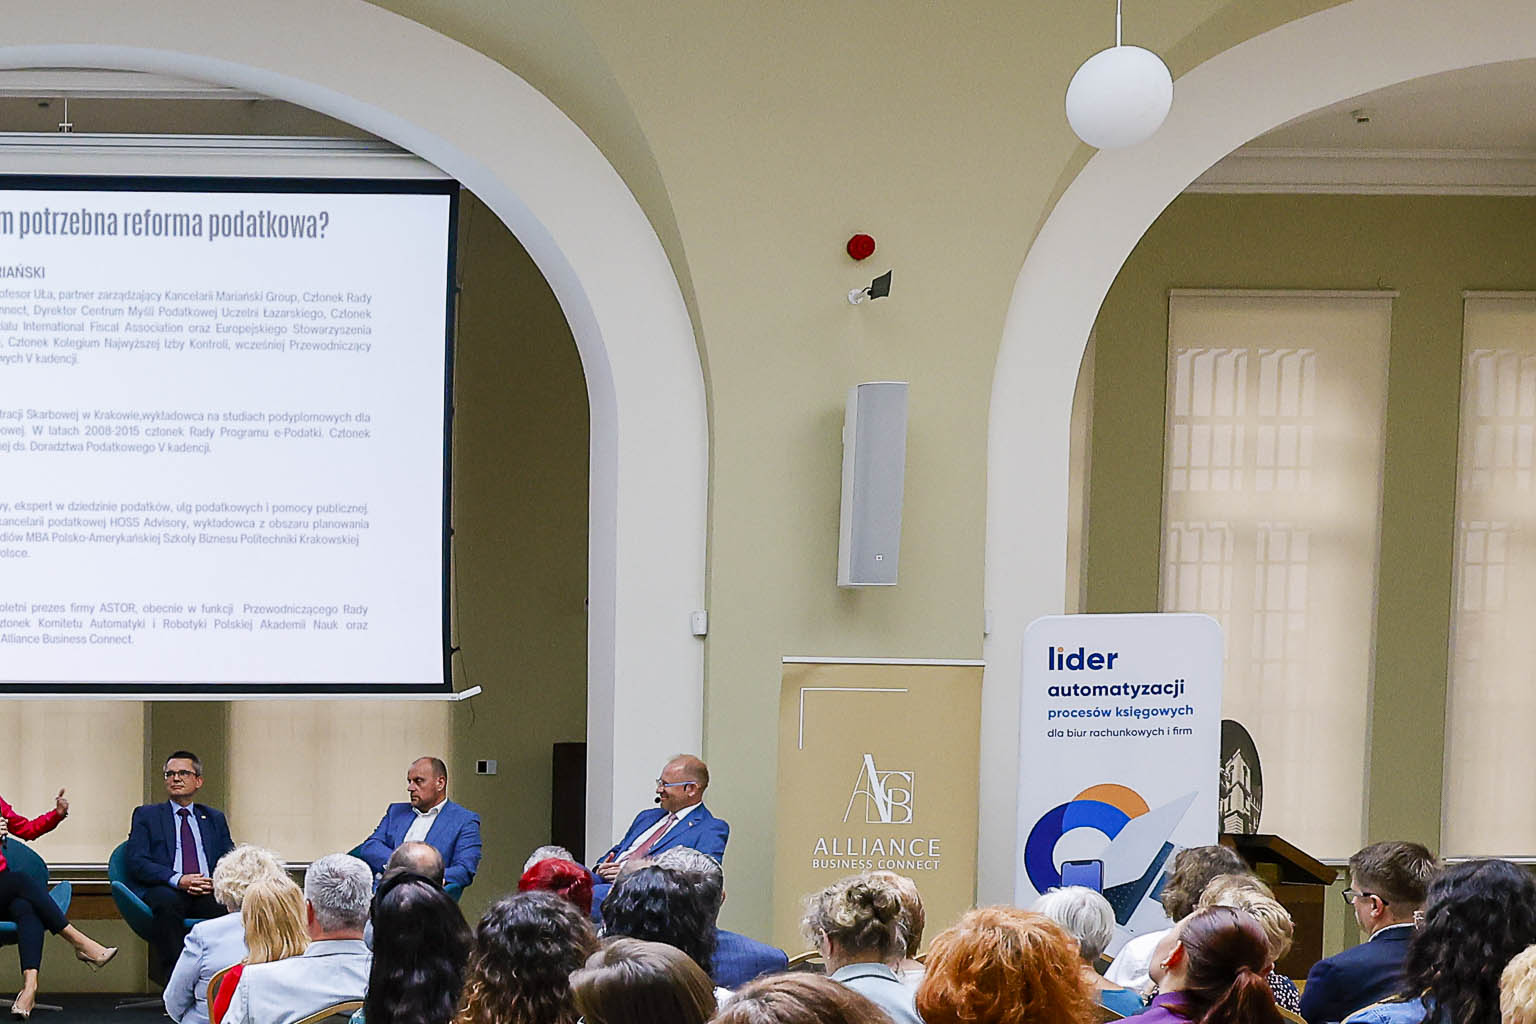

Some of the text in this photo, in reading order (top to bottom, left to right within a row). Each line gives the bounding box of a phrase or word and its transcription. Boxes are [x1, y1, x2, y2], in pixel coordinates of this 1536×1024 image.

[19, 207, 117, 240] potrzebna
[123, 208, 202, 237] reforma
[209, 209, 329, 243] podatkowa?
[1048, 647, 1118, 670] lider
[1048, 679, 1185, 699] automatyzacji
[1048, 704, 1194, 720] procesów księgowych
[1047, 726, 1193, 738] dla biur rachunkowych i firm
[813, 837, 941, 857] ALLIANCE
[812, 859, 940, 870] BUSINESS CONNECT
